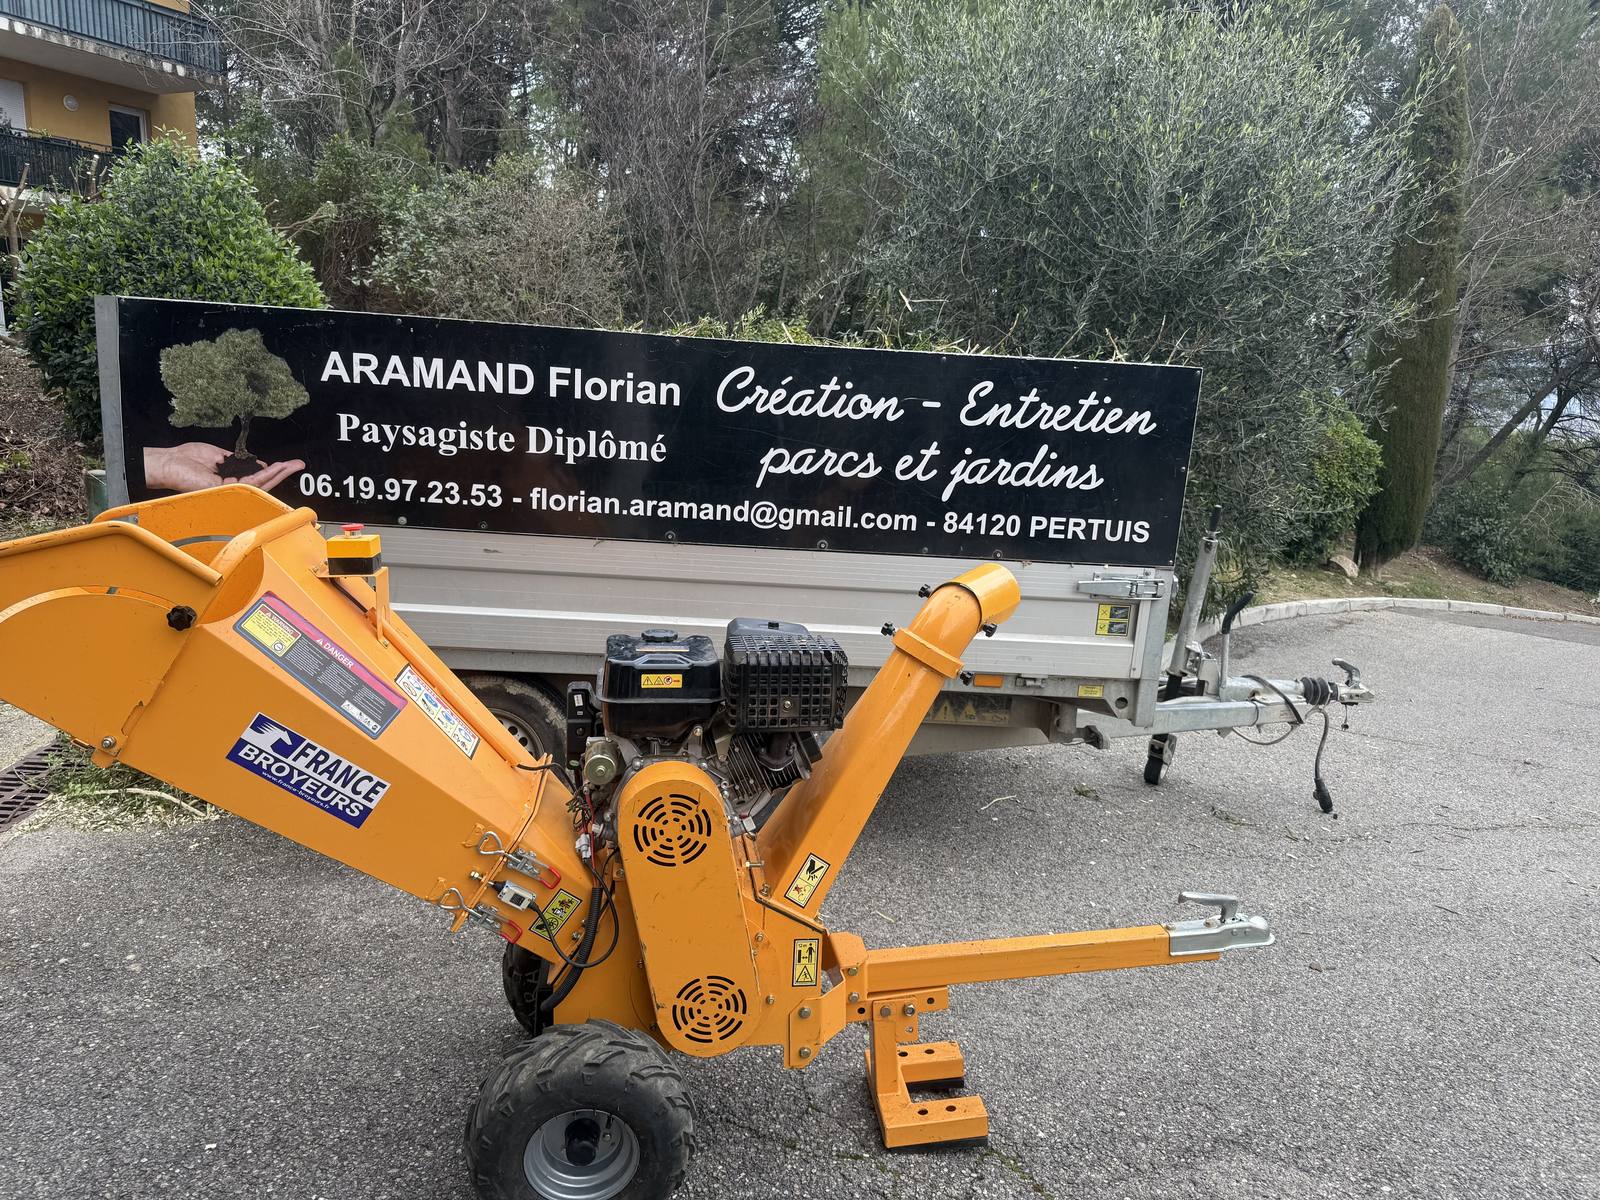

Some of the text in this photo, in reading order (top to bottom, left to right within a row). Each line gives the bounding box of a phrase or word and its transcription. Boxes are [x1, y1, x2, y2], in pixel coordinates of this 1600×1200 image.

[320, 350, 682, 407] ARAMAND Florian
[716, 365, 905, 422] Création
[959, 380, 1157, 436] Entretien
[336, 412, 668, 465] Paysagiste Diplômé
[755, 441, 1105, 503] parcs et jardins
[299, 472, 503, 508] 06.19.97.23.53
[529, 486, 918, 532] florian.aramand@gmail.com
[943, 511, 1021, 537] 84120
[1029, 515, 1150, 543] PERTUIS
[271, 613, 294, 635] WARNING
[323, 638, 354, 669] DANGER
[237, 743, 364, 818] BROYEURS
[292, 742, 388, 804] FRANCE
